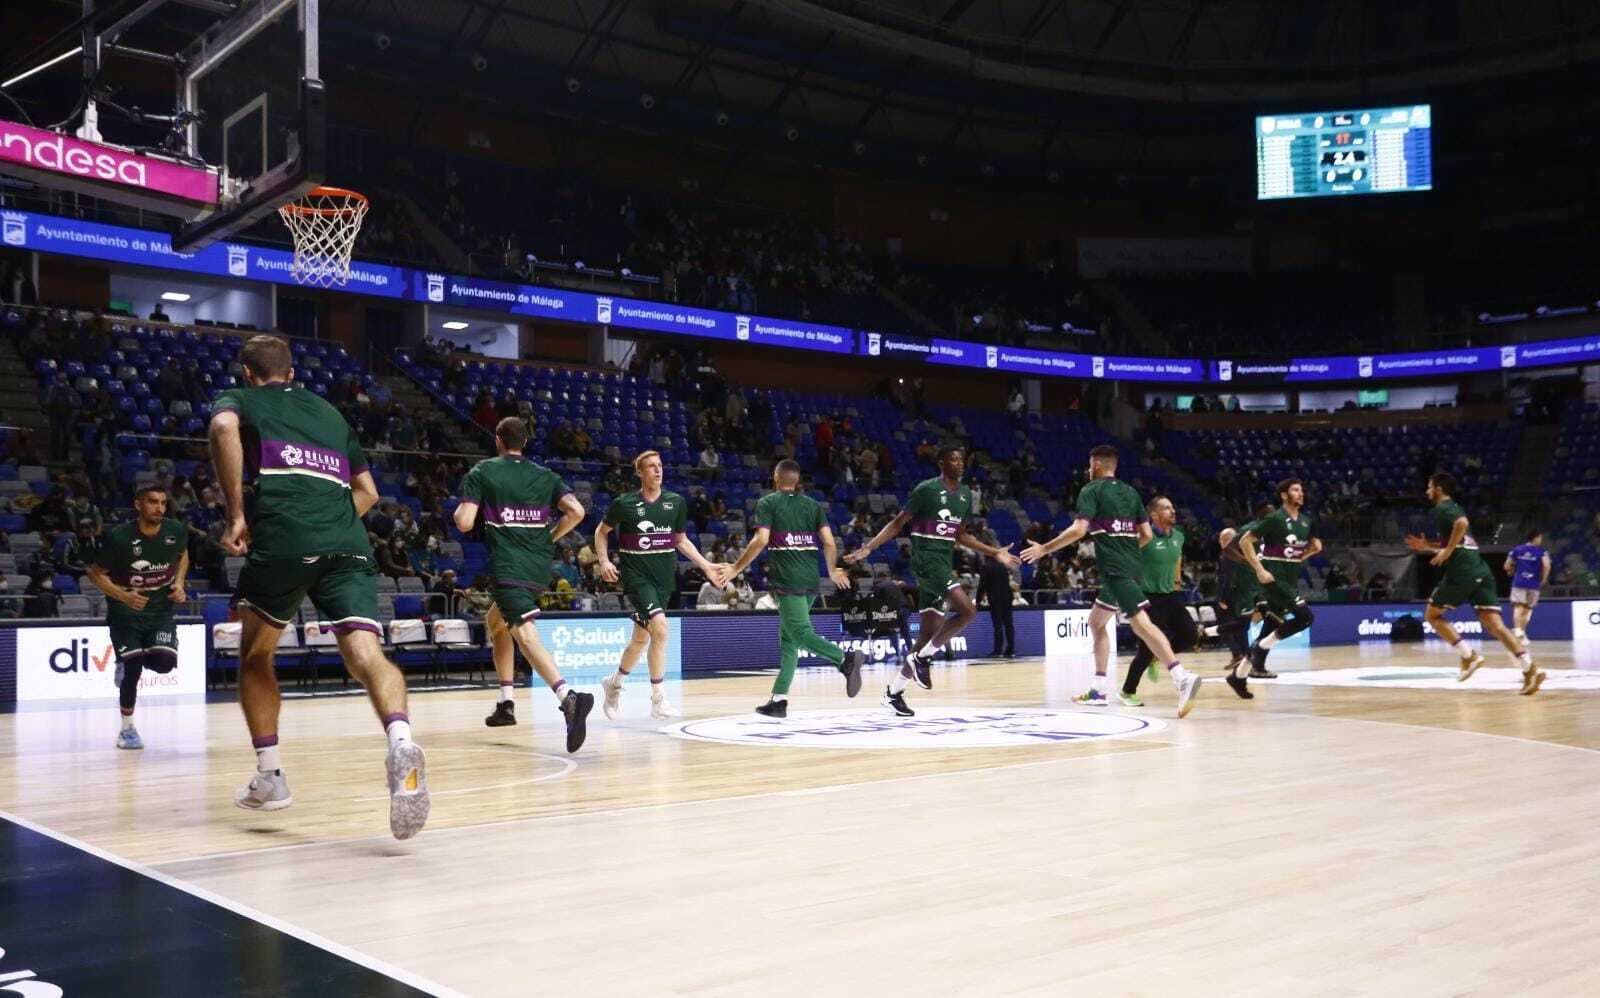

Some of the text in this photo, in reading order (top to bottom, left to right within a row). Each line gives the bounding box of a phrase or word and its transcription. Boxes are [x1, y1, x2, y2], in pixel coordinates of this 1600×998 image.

[0, 132, 147, 186] ndesa
[37, 225, 128, 249] Ayuntamiento
[132, 240, 147, 251] de
[257, 257, 333, 273] Ayunta
[350, 269, 388, 285] Málaga
[451, 284, 564, 309] Ayuntamiento de Málaga
[618, 306, 715, 328] Ayuntamiento de Málaga
[755, 324, 842, 344] Ayuntamiento de Málaga
[885, 340, 930, 353] Ayuntamiento
[940, 346, 963, 357] Málaga
[573, 626, 626, 645] Salud
